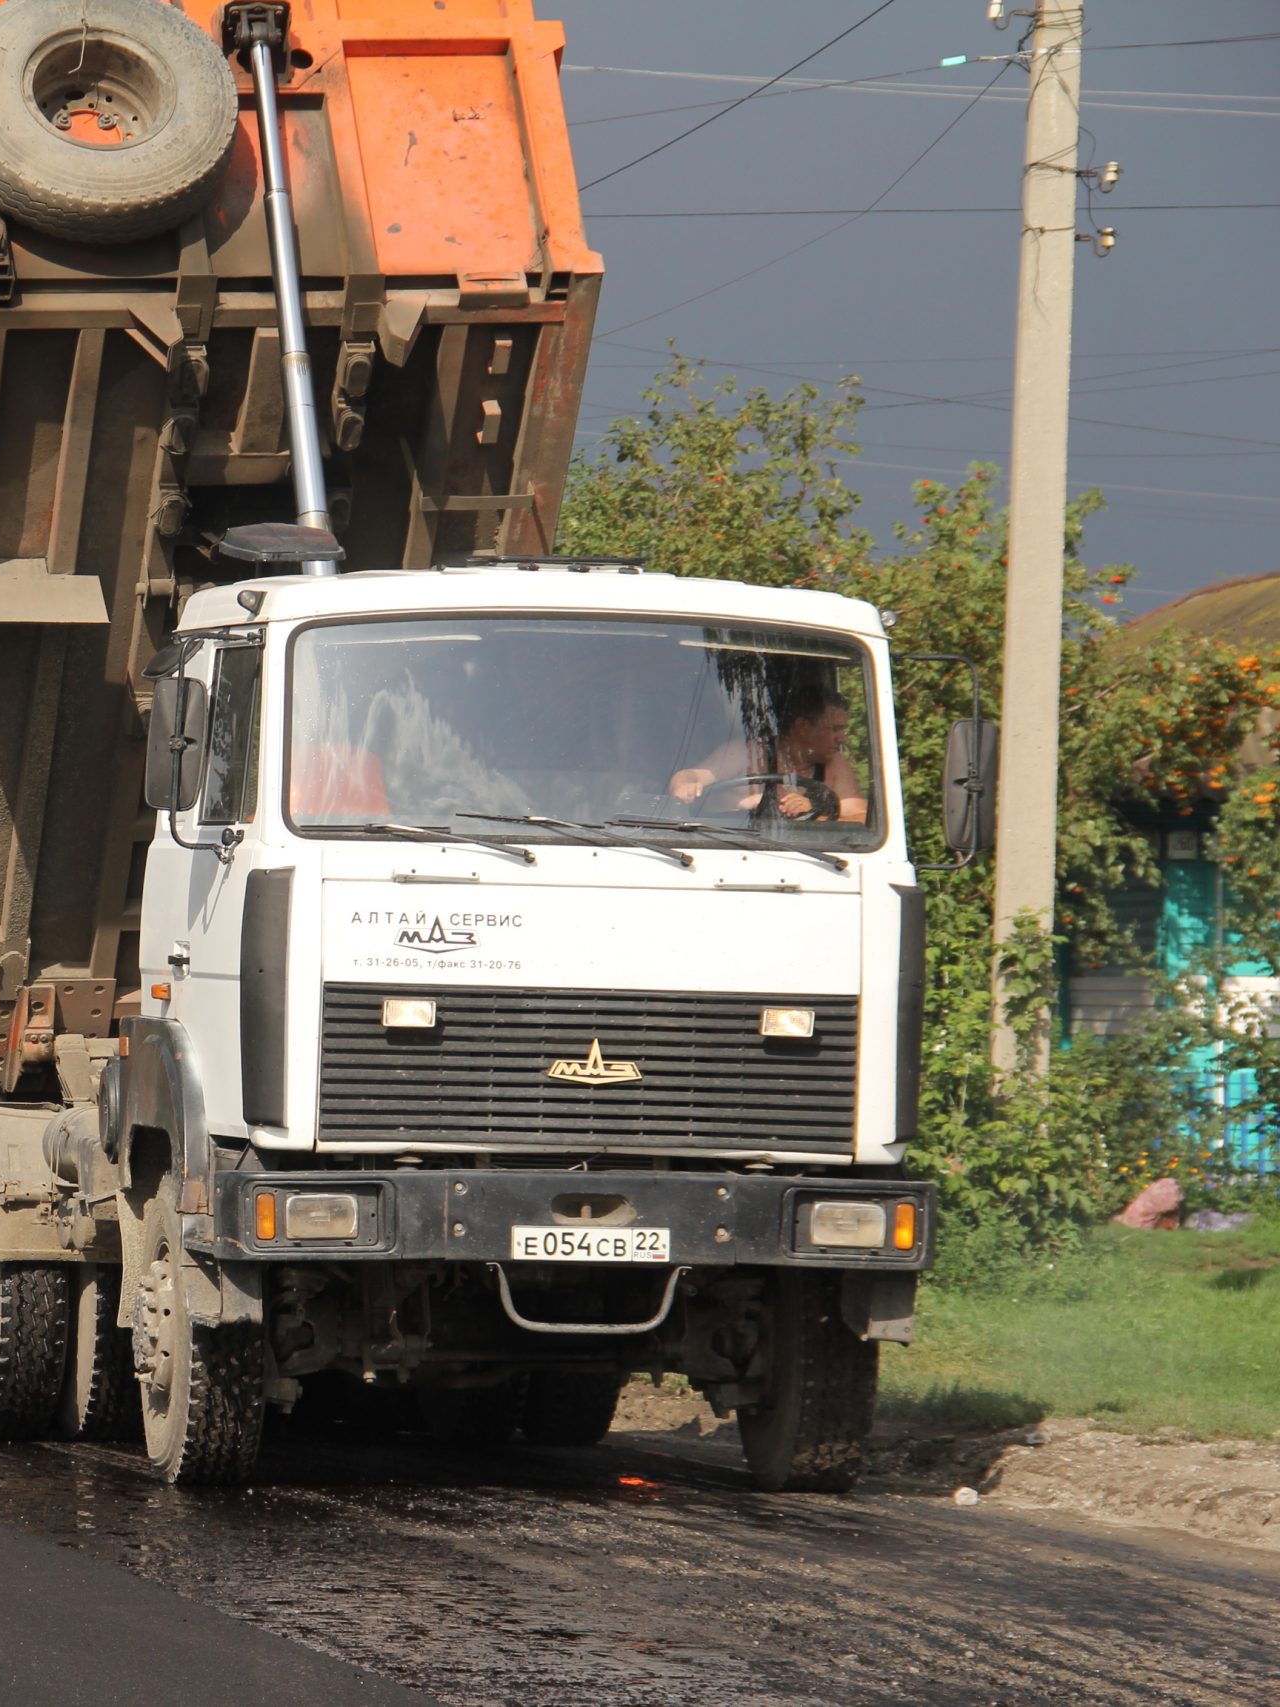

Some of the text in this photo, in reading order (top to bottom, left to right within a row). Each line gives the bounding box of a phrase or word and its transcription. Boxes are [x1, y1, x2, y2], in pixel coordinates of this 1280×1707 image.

[351, 910, 523, 927] АЛТАЙ СЕРВИС
[426, 959, 466, 969] т/факс
[470, 959, 522, 970] 31-20-76
[635, 1231, 660, 1250] 22
[633, 1251, 652, 1259] RUS
